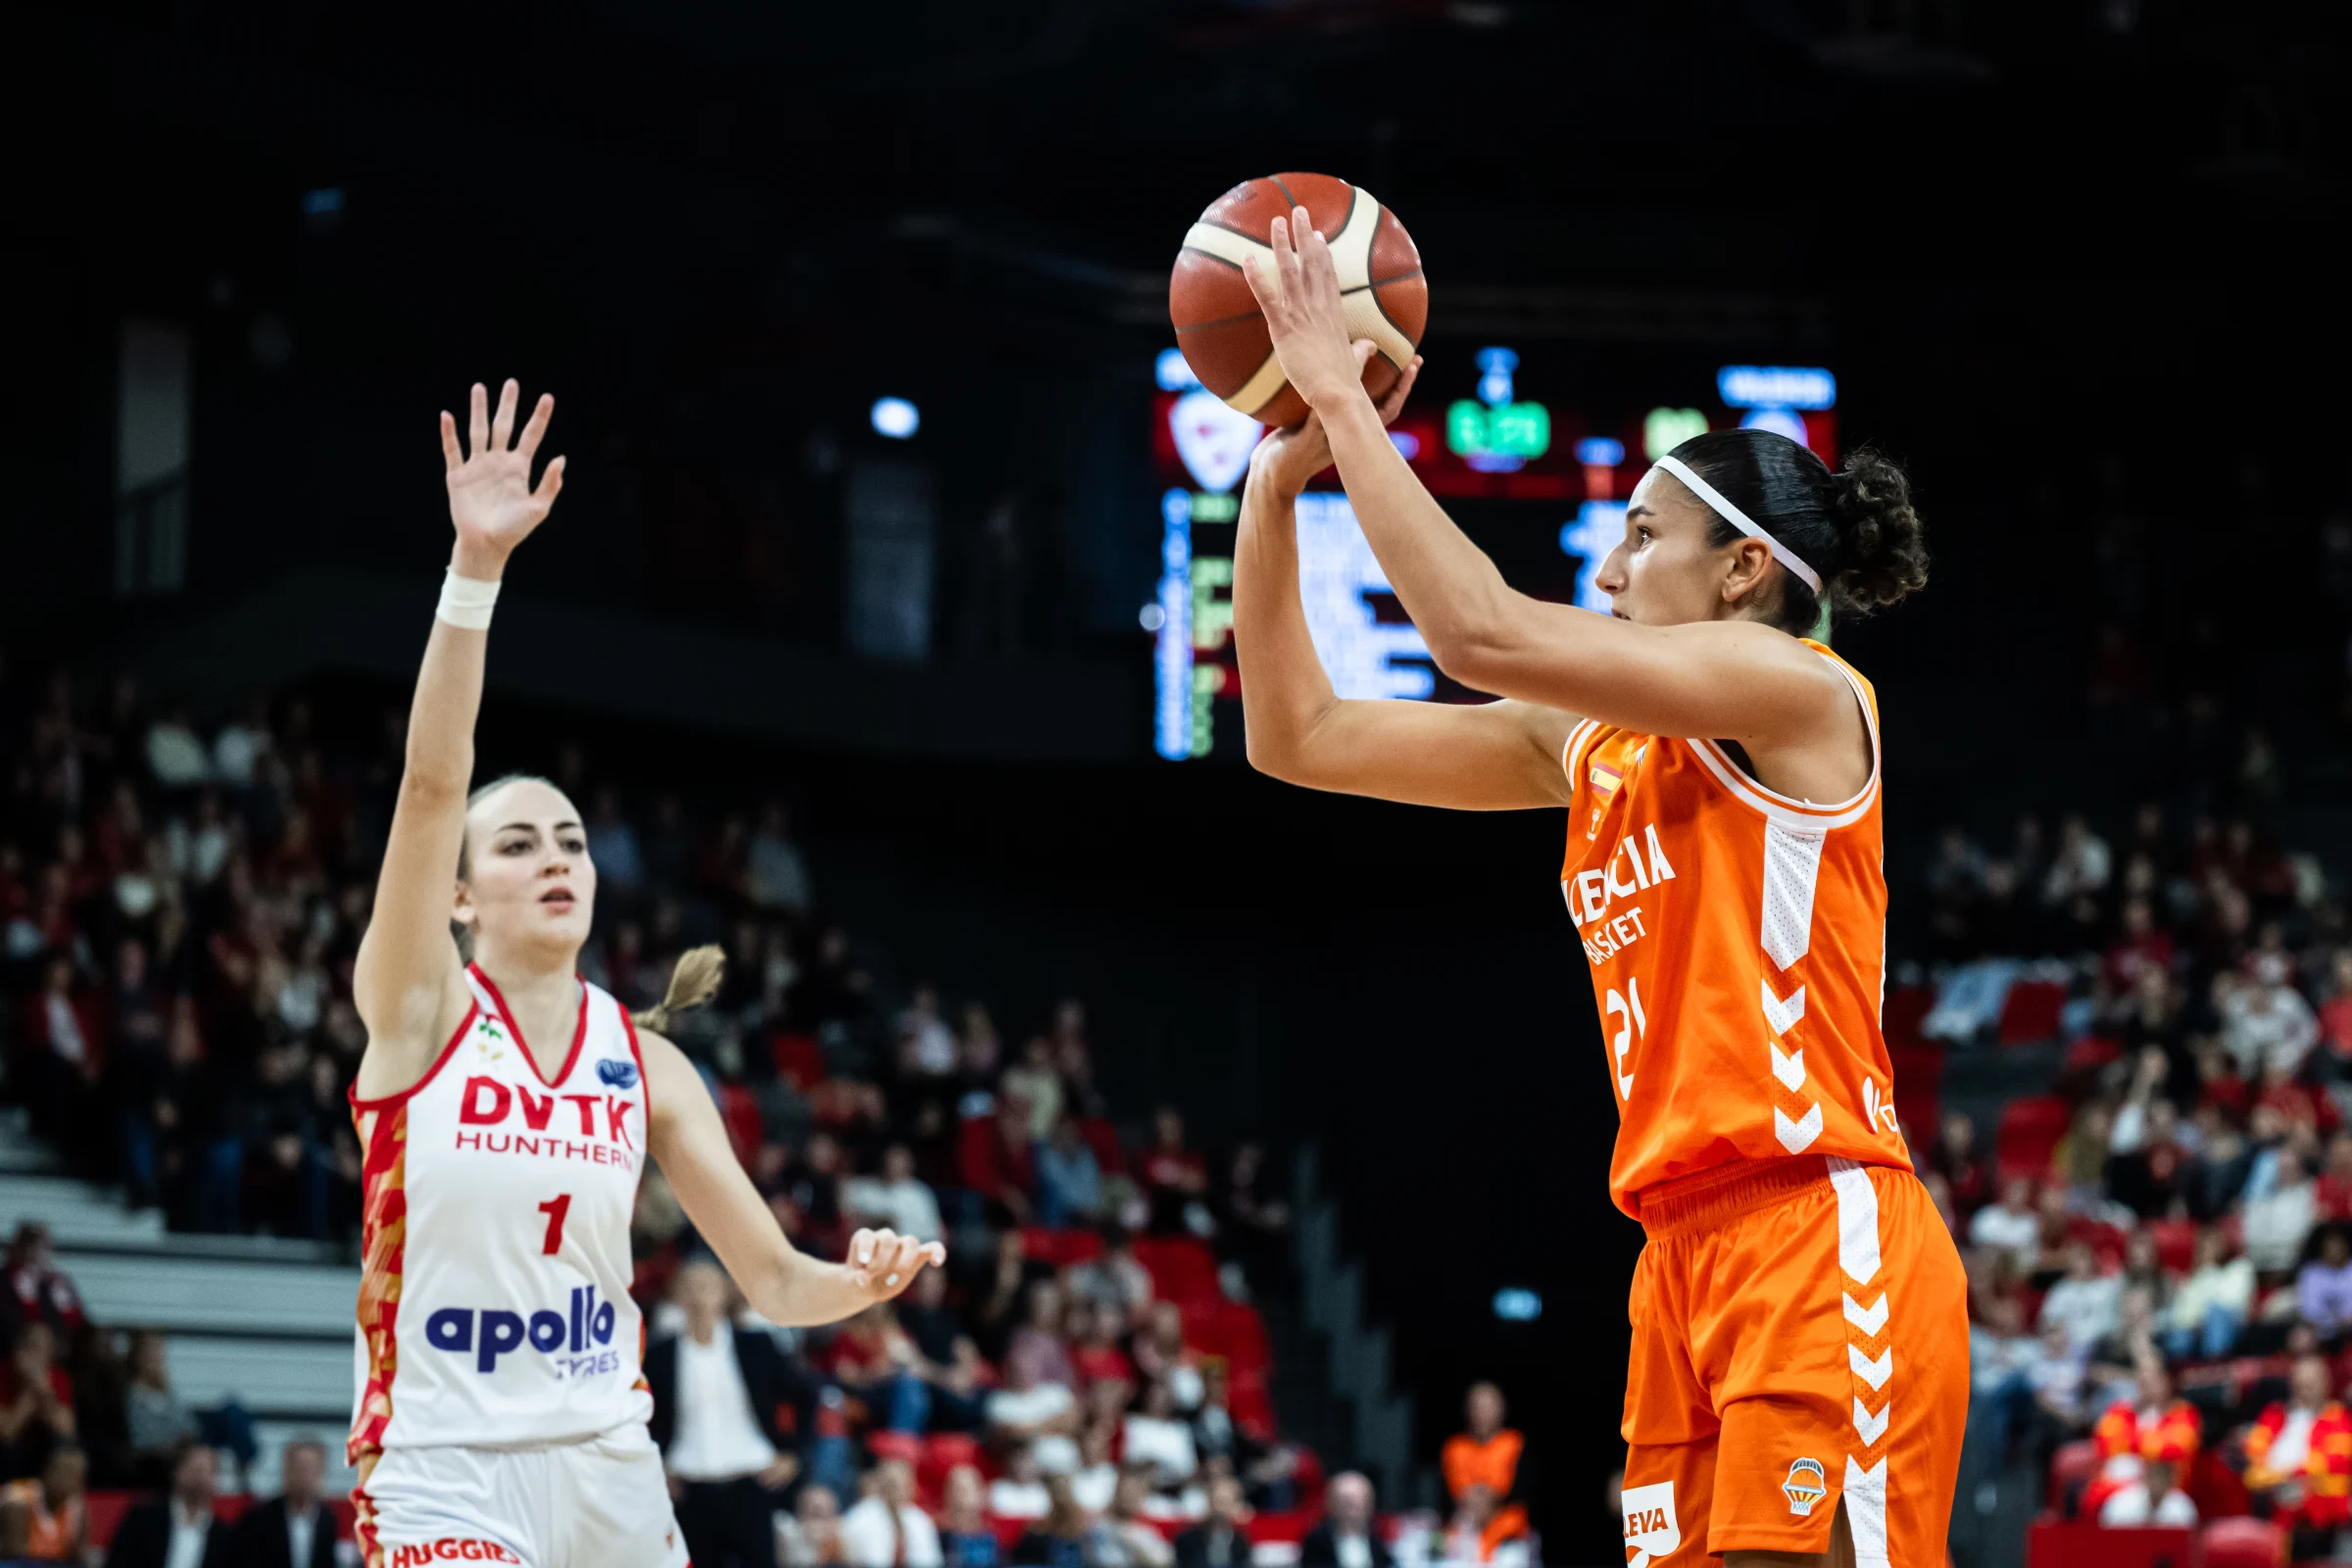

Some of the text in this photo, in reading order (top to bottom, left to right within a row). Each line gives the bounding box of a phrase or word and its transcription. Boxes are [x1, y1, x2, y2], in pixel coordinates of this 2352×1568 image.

[1606, 976, 1645, 1102] 21
[459, 1075, 635, 1152] DVTK
[538, 1193, 572, 1255] 1
[425, 1285, 614, 1373] apollo
